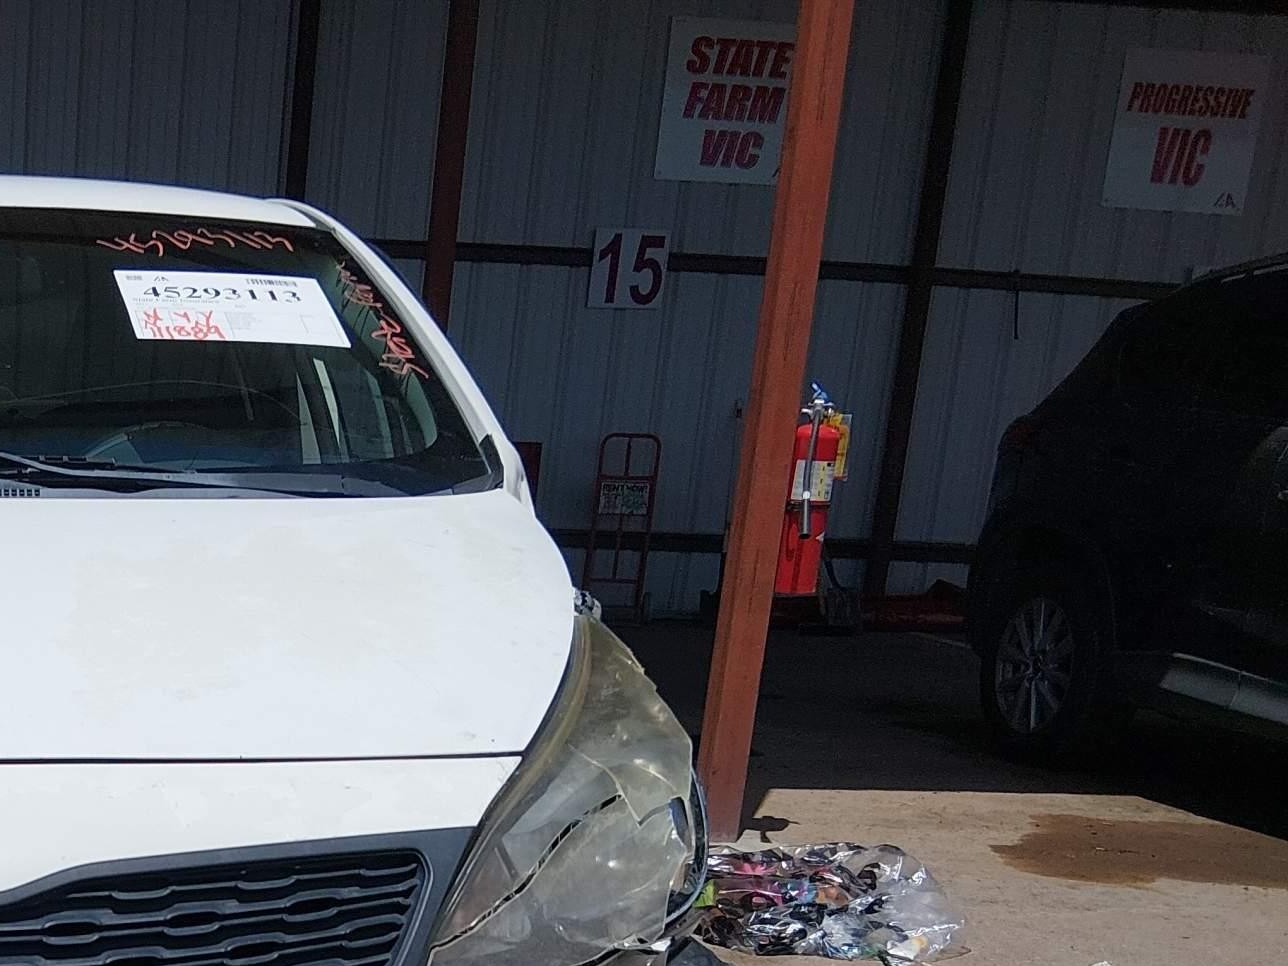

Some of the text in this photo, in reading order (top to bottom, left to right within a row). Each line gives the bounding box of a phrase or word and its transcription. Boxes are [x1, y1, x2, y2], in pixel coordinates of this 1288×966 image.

[686, 36, 795, 80] STATE
[682, 82, 787, 124] FARM
[1127, 82, 1256, 119] PROGRESSIVE
[699, 129, 764, 170] VIC
[1150, 127, 1212, 187] VIC
[598, 232, 666, 306] 15
[144, 286, 302, 304] 45293113
